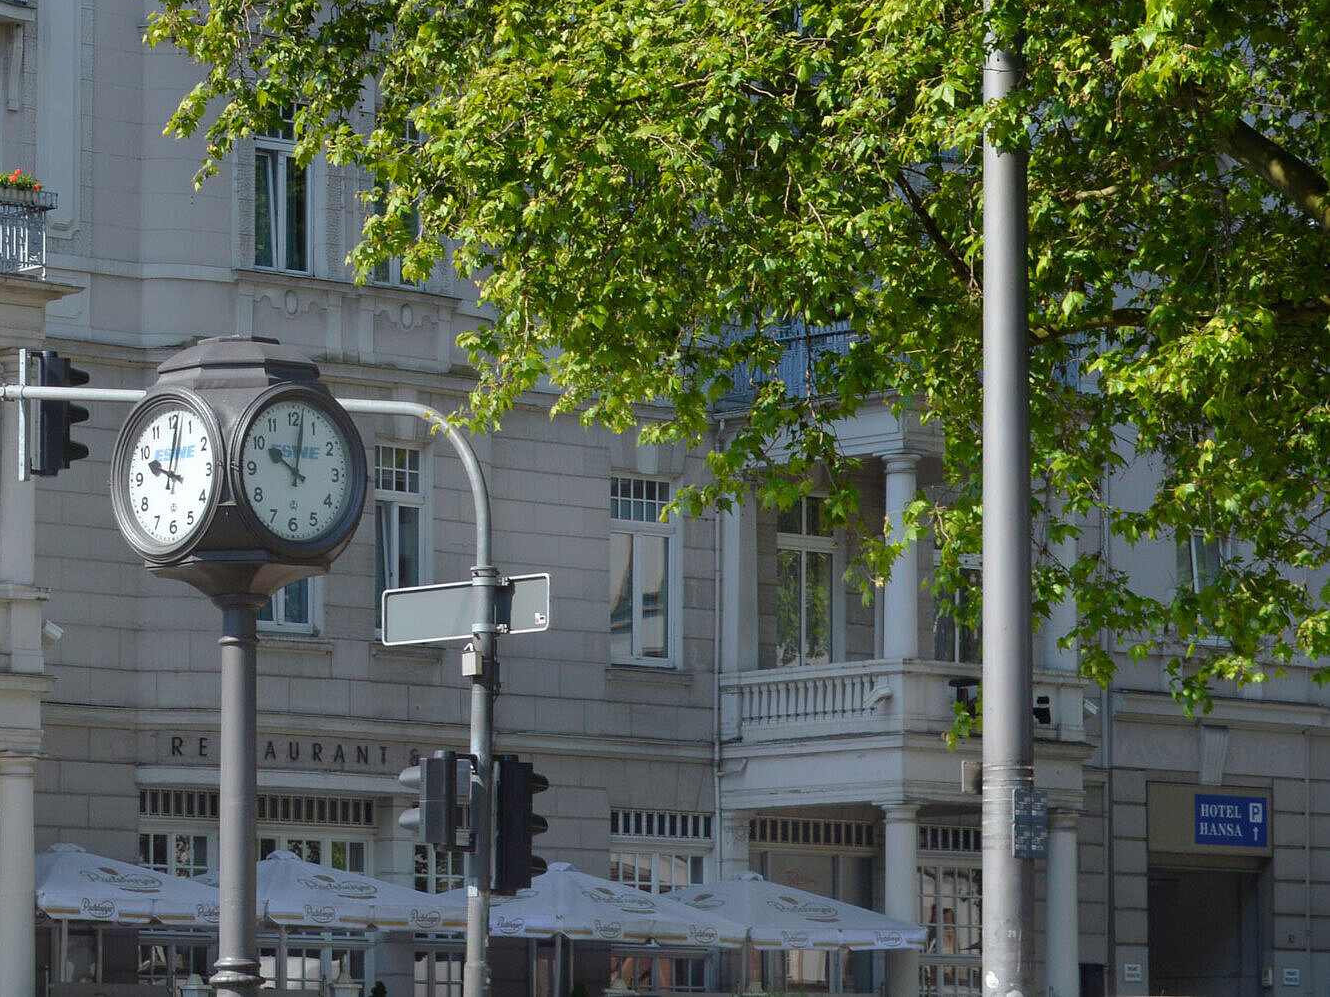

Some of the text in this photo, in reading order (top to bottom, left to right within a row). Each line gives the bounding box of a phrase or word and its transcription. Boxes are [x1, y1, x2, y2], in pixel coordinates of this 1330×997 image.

[168, 414, 179, 430] 12
[268, 417, 277, 433] 11
[287, 411, 300, 427] 12
[152, 425, 160, 440] 11
[200, 436, 208, 451] 2
[253, 435, 265, 450] 10
[325, 442, 334, 457] 2
[140, 445, 150, 461] 10
[205, 462, 213, 477] 3
[247, 460, 257, 476] 9
[332, 468, 340, 483] 3
[135, 472, 144, 487] 9
[198, 488, 207, 503] 4
[253, 486, 263, 502] 8
[323, 493, 333, 509] 4
[141, 496, 149, 512] 8
[154, 515, 161, 531] 7
[186, 510, 195, 526] 5
[269, 508, 278, 524] 7
[309, 511, 318, 527] 5
[169, 519, 178, 535] 6
[287, 517, 298, 532] 6
[171, 736, 388, 766] REAURANT
[1200, 803, 1242, 819] HOTEL
[1199, 822, 1243, 837] HANSA
